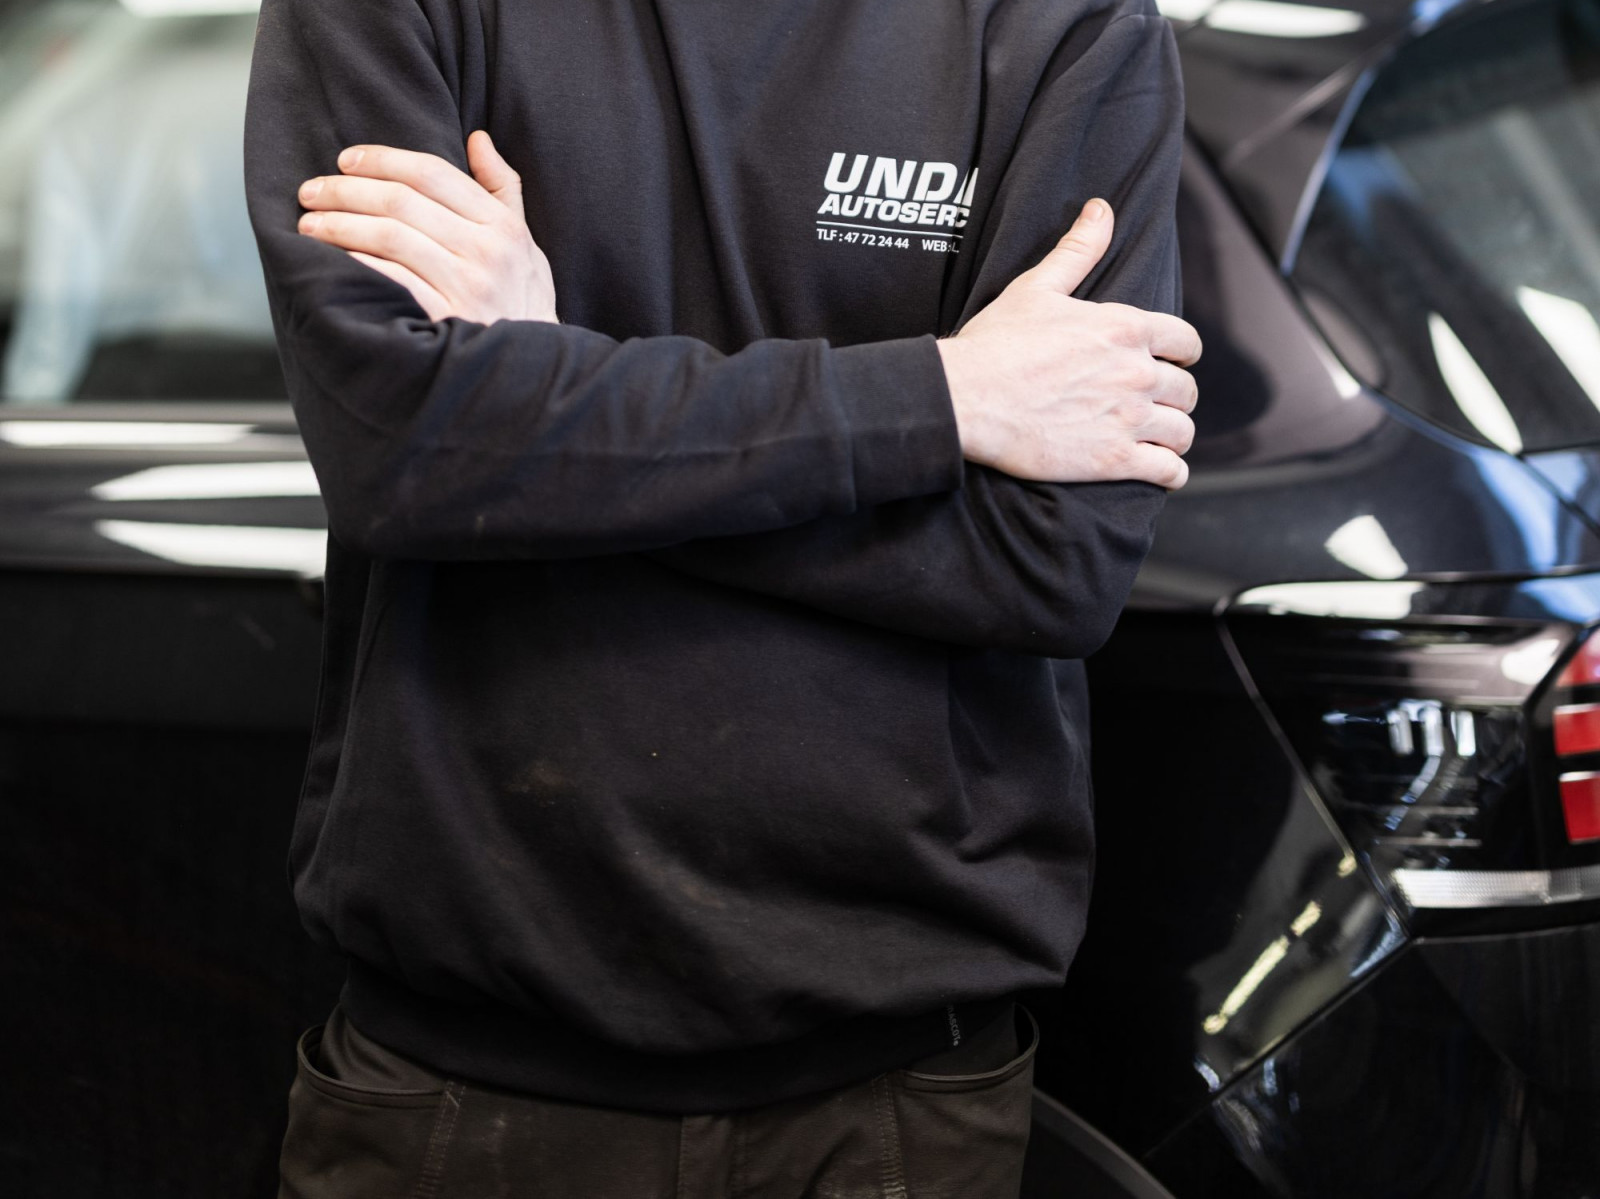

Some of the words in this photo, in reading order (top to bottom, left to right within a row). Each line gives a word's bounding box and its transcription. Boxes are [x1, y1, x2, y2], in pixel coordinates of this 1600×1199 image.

[844, 231, 860, 243] 47
[861, 233, 876, 246] 72
[877, 235, 893, 248] 24
[894, 237, 910, 249] 44
